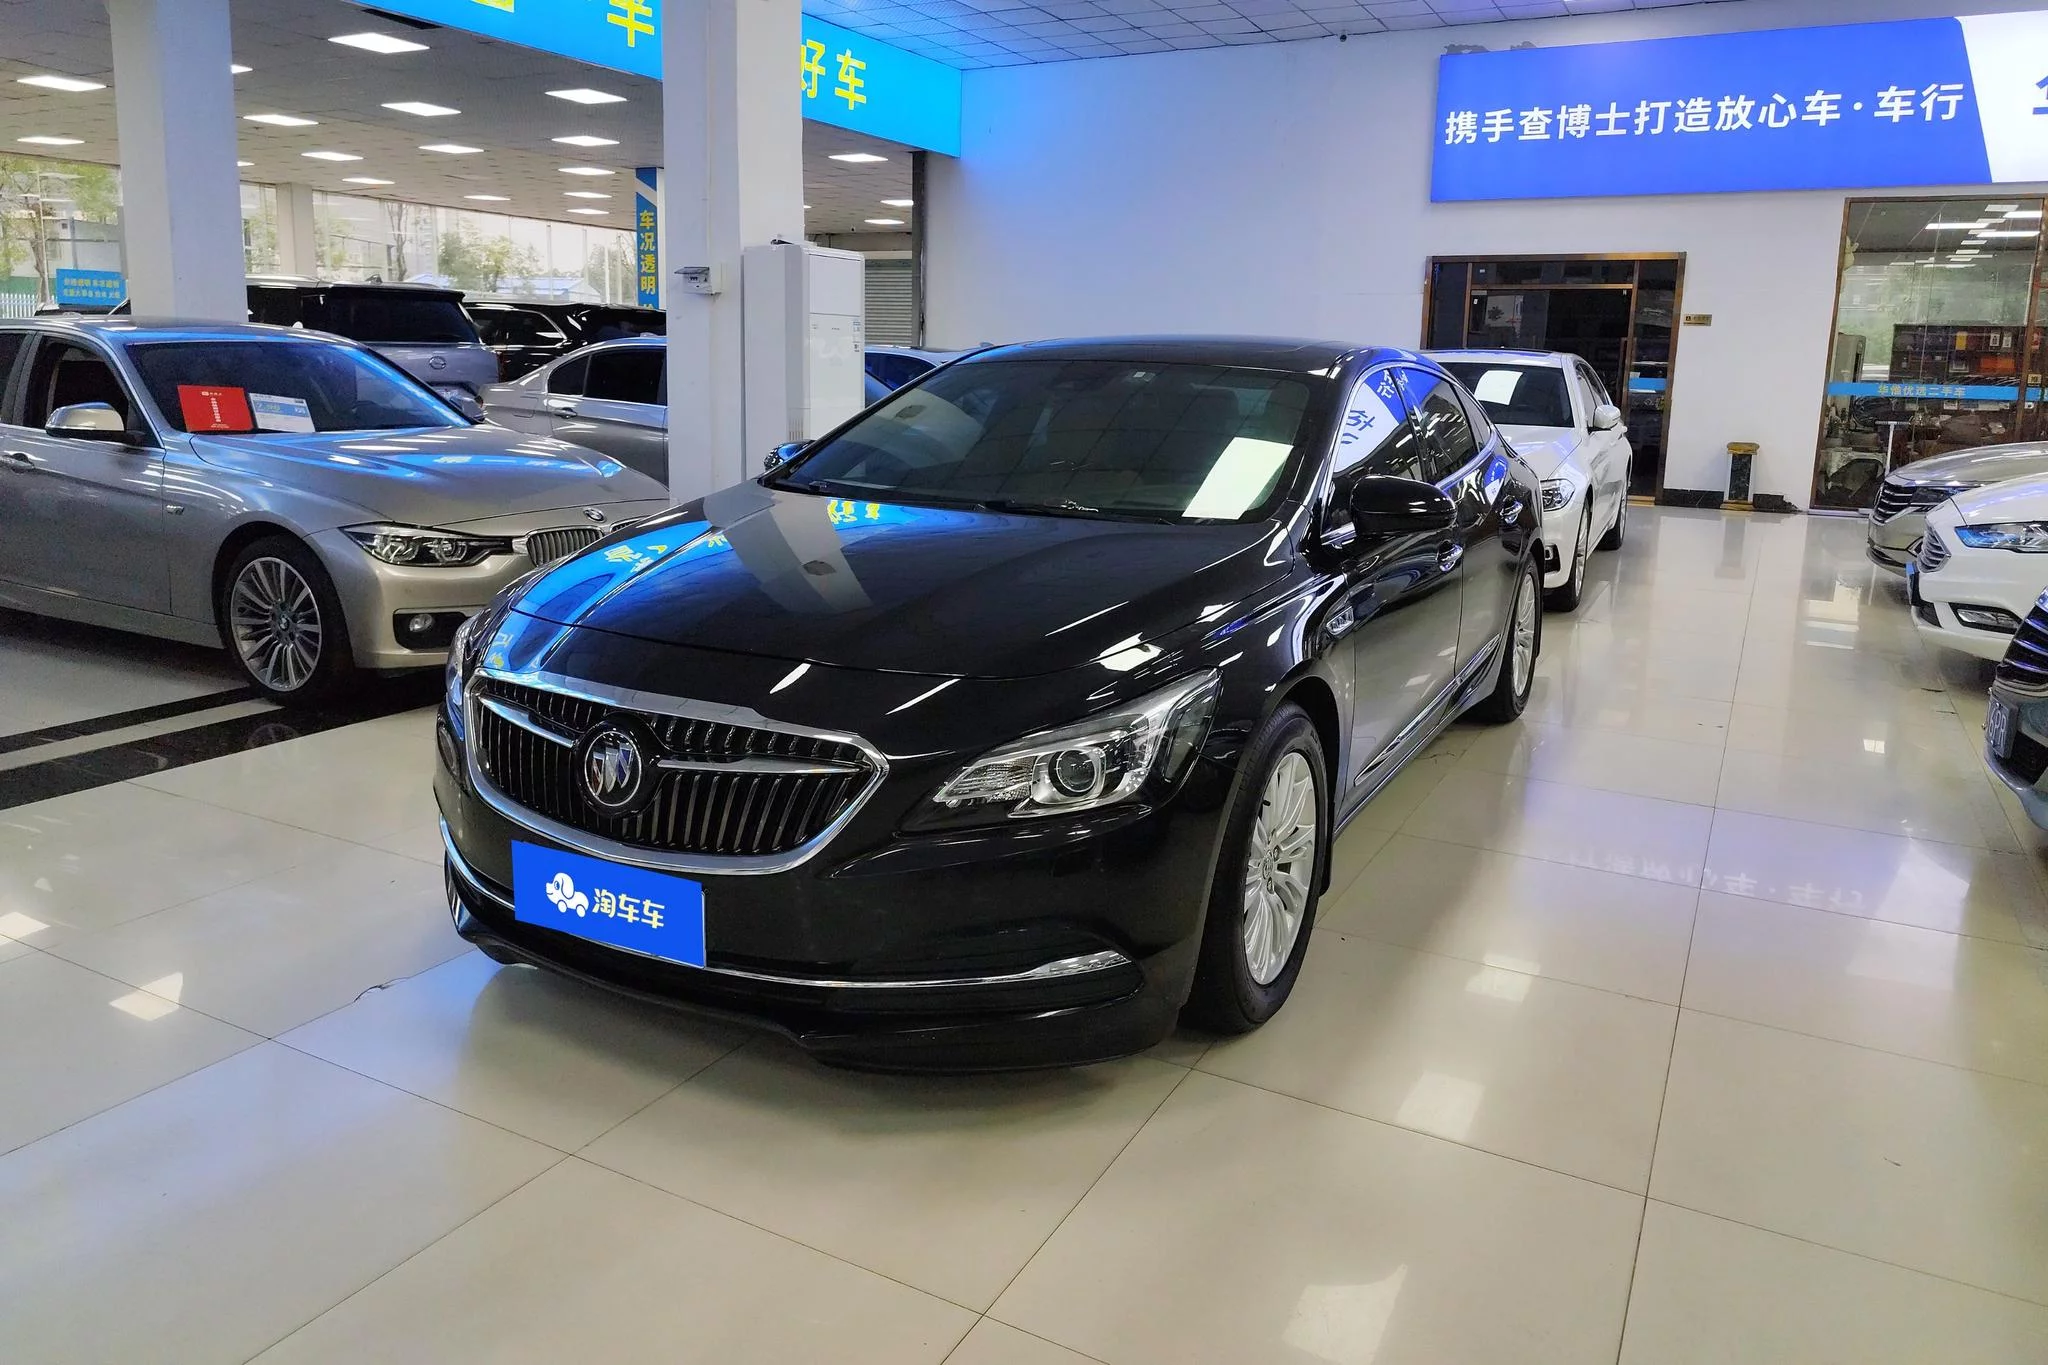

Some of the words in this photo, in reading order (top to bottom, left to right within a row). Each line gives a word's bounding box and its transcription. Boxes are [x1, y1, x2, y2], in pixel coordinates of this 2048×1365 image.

[801, 39, 867, 111] 好车
[1445, 82, 1965, 145] 携手查博士打造放心车·车行
[640, 210, 656, 295] 车况透明
